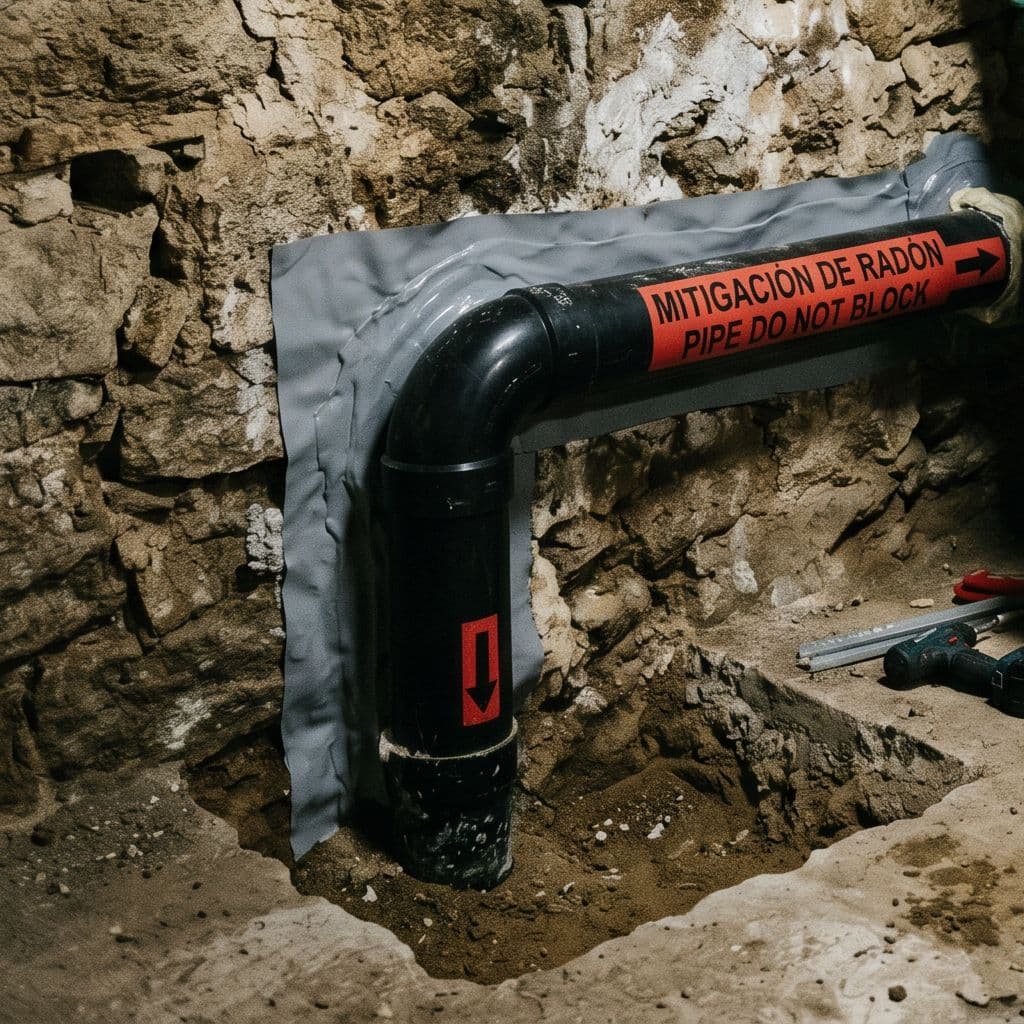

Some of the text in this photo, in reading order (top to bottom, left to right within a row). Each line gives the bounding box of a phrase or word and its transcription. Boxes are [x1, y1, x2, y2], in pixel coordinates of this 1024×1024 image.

[817, 258, 855, 291] DE
[682, 281, 928, 360] PIPE DO NOT BLOCK
